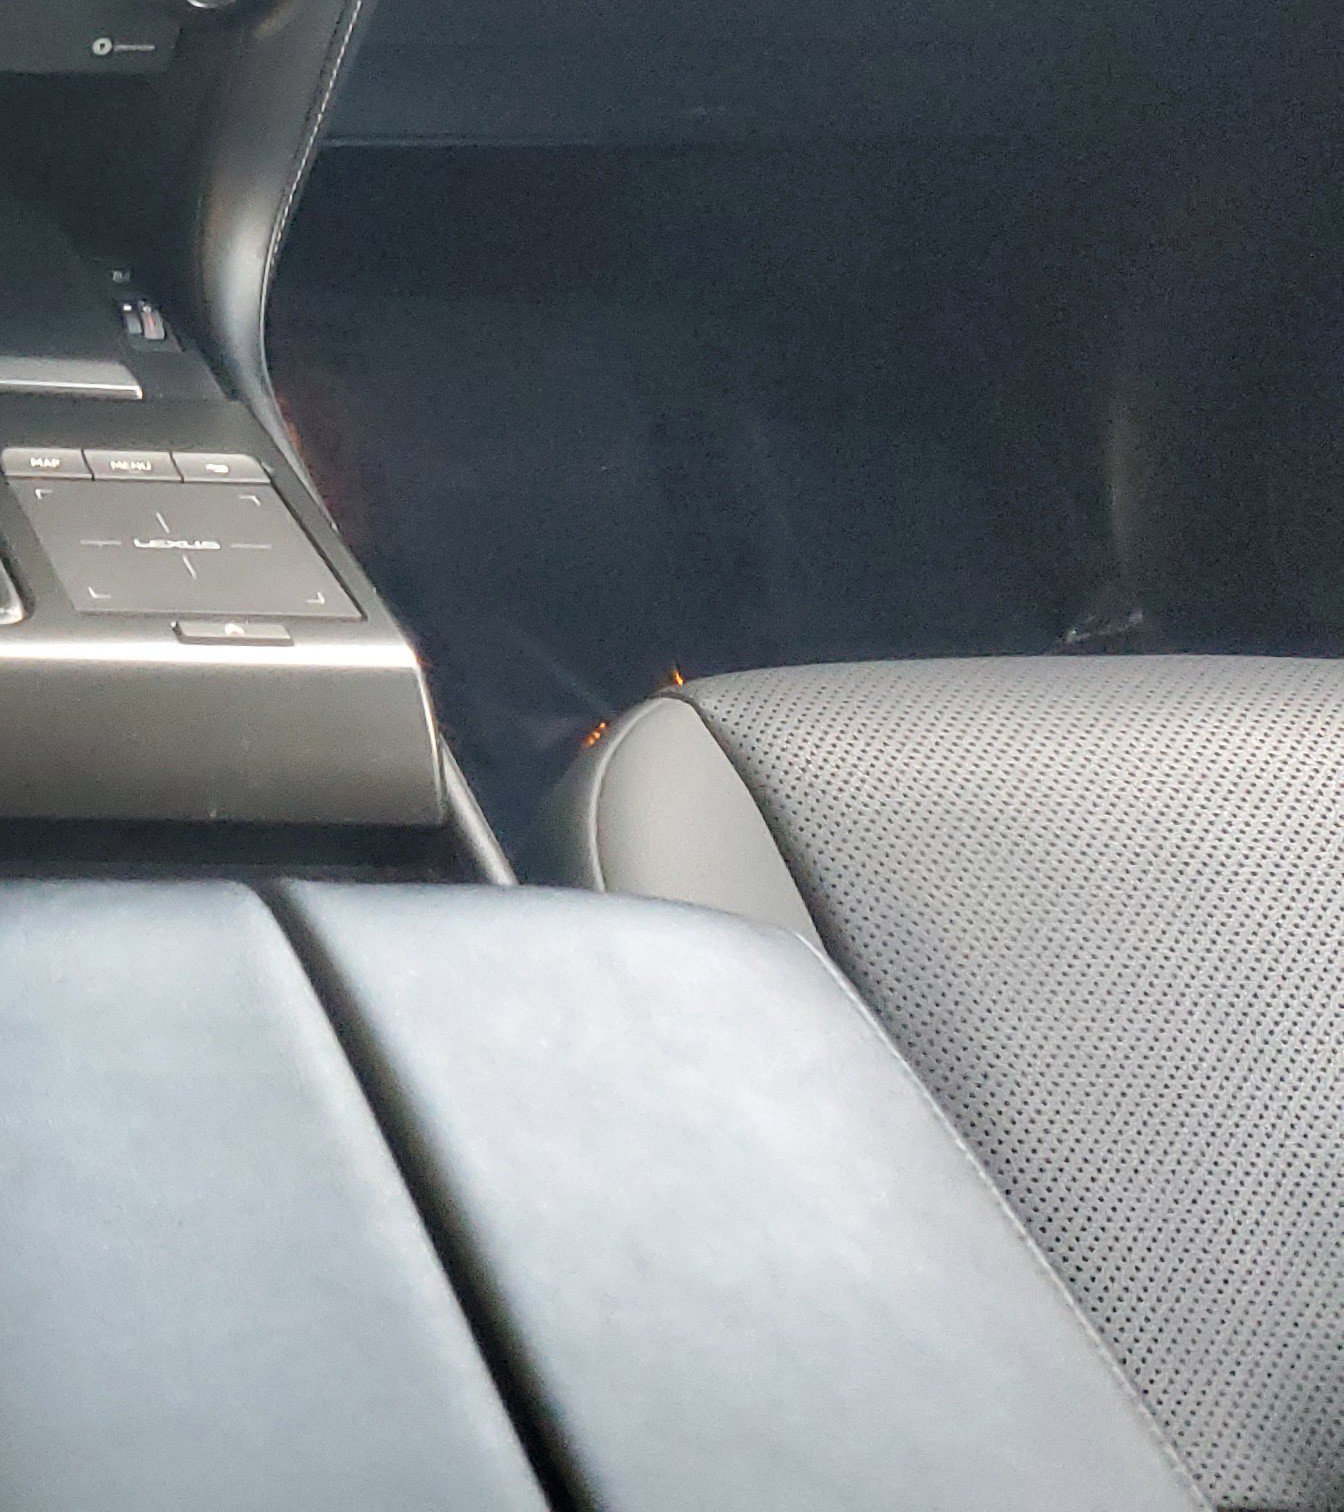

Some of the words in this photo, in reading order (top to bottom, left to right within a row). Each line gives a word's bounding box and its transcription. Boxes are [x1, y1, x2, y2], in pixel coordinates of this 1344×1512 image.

[30, 457, 60, 469] MAP
[110, 459, 153, 472] MENU
[133, 538, 221, 550] LEXUS
